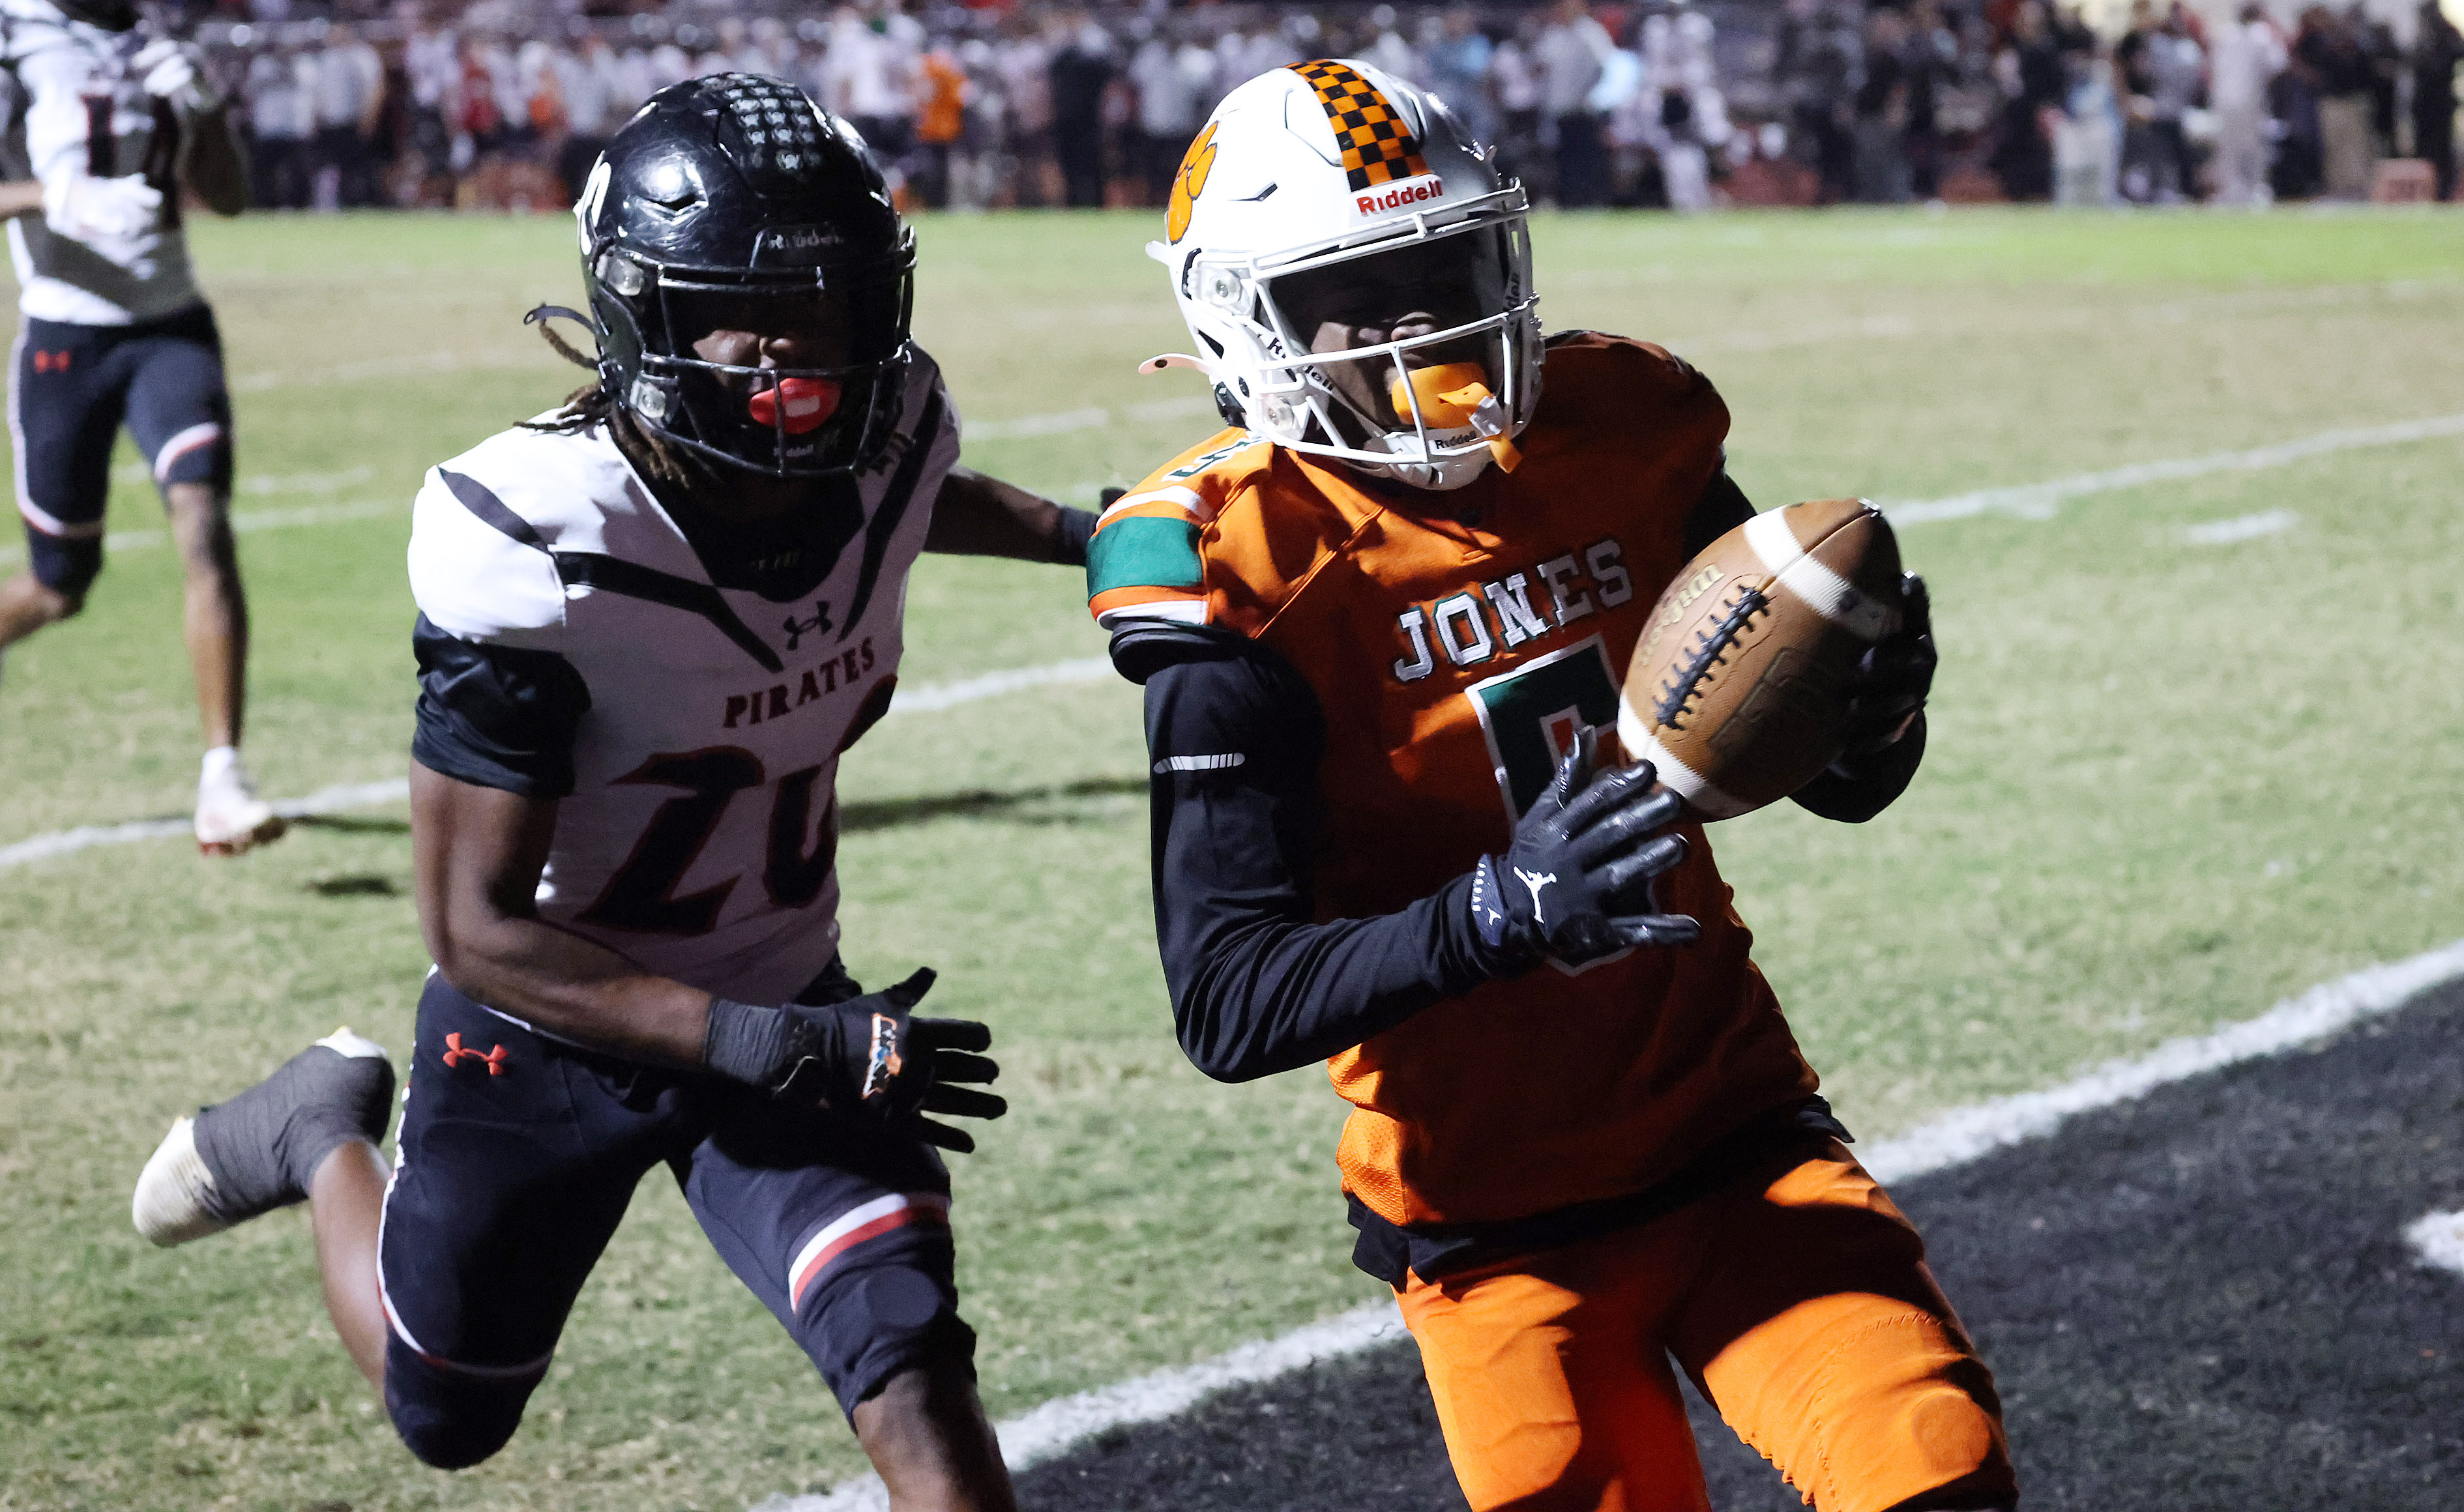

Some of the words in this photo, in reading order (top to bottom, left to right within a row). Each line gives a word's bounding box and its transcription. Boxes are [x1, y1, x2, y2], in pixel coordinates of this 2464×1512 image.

[1357, 180, 1443, 217] Riddell
[1435, 430, 1477, 450] Riddell
[1394, 538, 1634, 682] JONES
[722, 636, 875, 729] PIRATES
